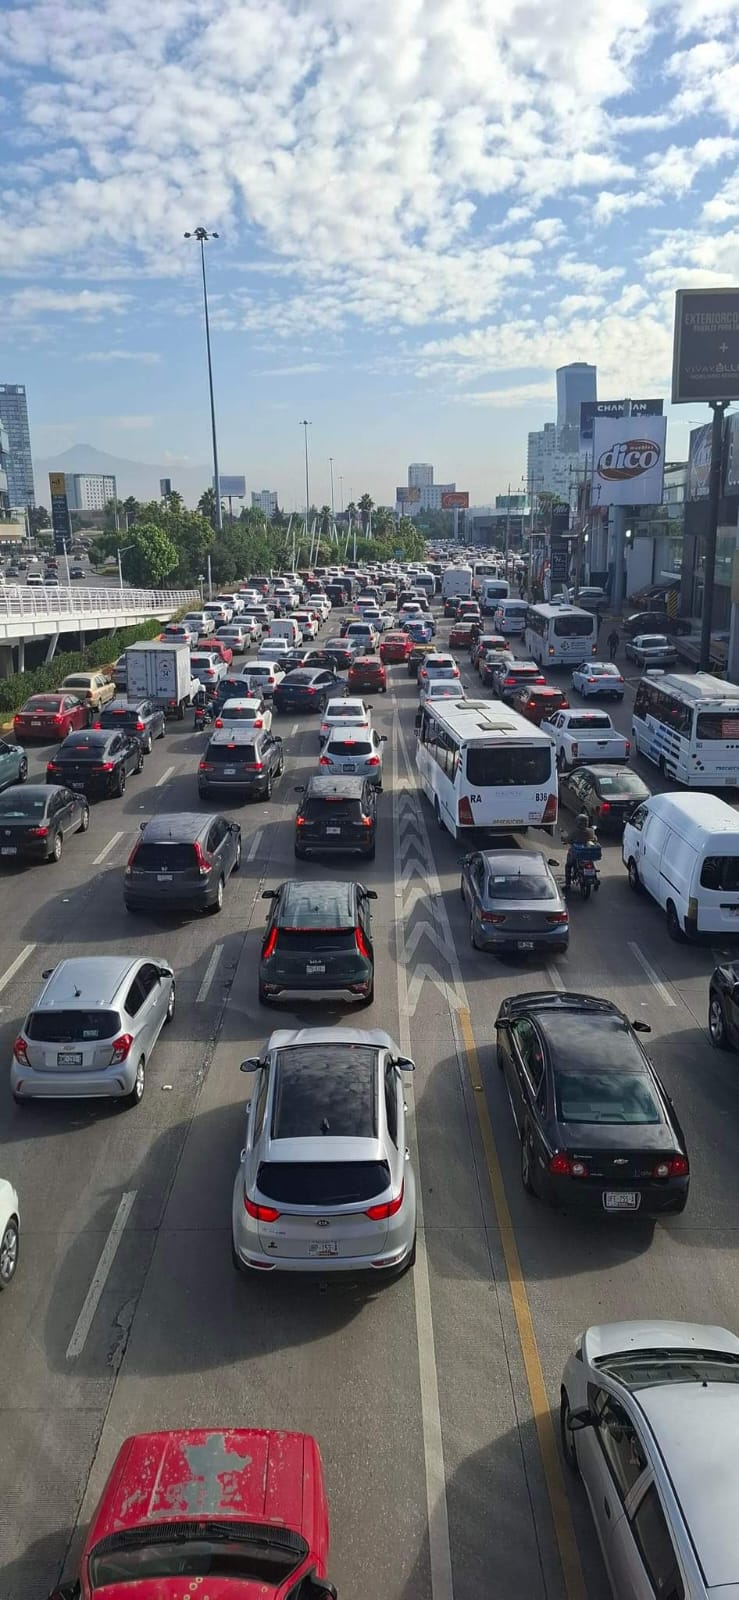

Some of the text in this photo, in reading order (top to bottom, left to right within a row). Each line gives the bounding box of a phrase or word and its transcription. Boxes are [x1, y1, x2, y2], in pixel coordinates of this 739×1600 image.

[597, 403, 647, 412] CHANAN
[600, 444, 659, 469] dico
[470, 794, 482, 803] RA
